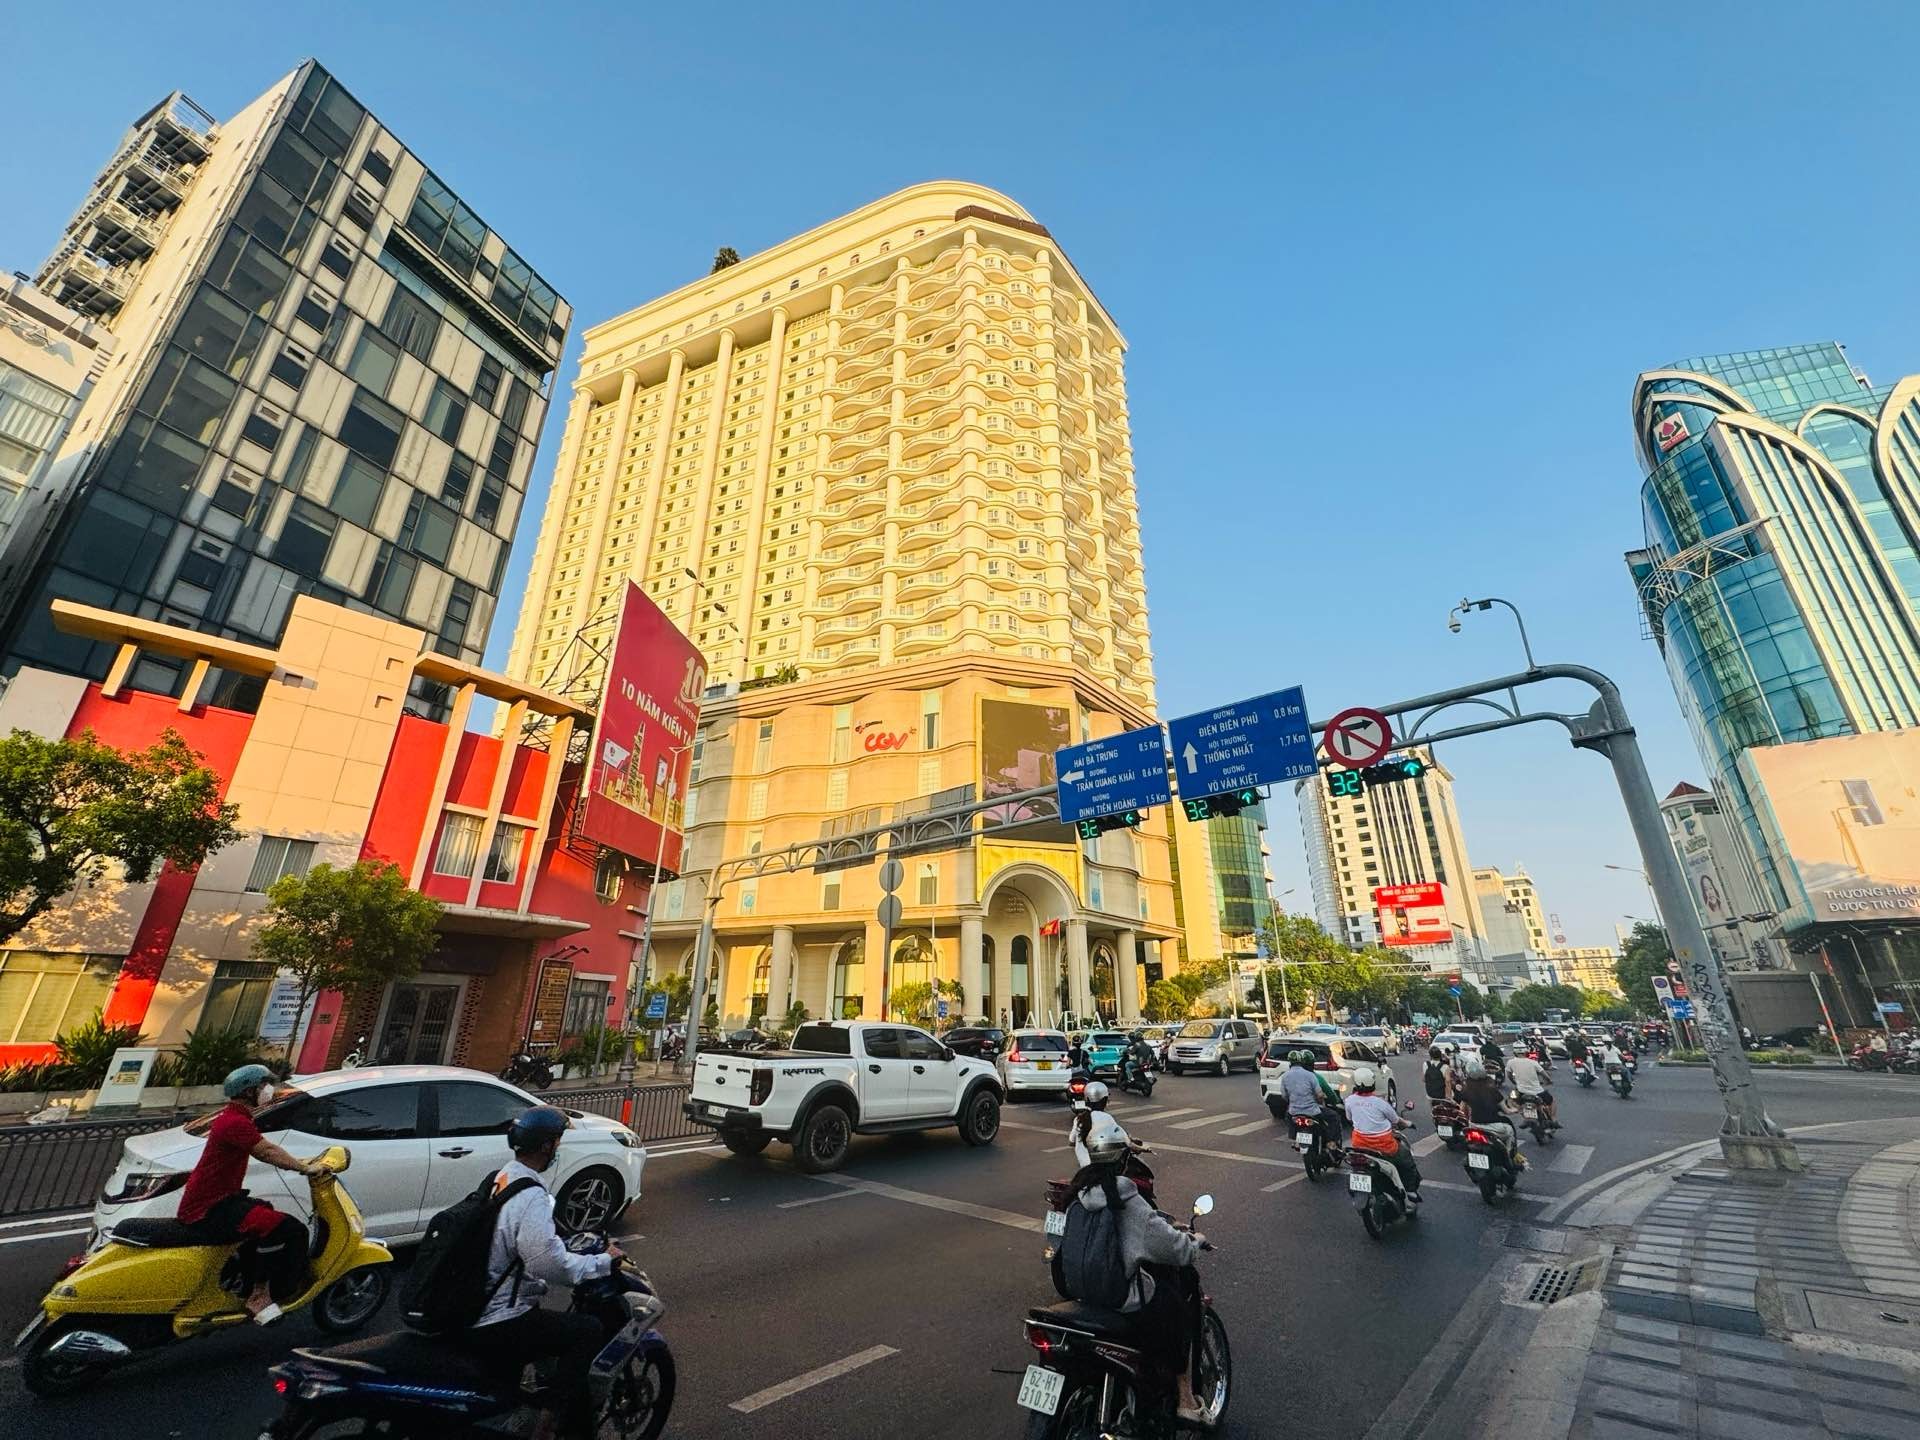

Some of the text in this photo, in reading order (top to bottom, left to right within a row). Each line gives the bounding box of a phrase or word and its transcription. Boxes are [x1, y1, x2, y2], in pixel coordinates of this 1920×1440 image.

[682, 656, 706, 700] 10
[621, 677, 635, 700] 10
[636, 691, 662, 722] NĂM
[1199, 723, 1218, 737] ĐIỆN
[1220, 718, 1239, 733] BIÊN
[1287, 704, 1300, 716] Km
[865, 732, 909, 752] CGV
[1204, 747, 1231, 764] THỐNG
[1232, 742, 1254, 757] NHẤT
[1292, 734, 1306, 745] Km
[1073, 756, 1085, 768] HAI
[1086, 752, 1095, 764] BÀ
[1095, 749, 1119, 762] TRƯNG
[1149, 740, 1160, 749] Km
[1095, 775, 1117, 789] QUANG
[1240, 772, 1259, 785] KIỆT
[1299, 764, 1312, 775] Km
[1331, 771, 1359, 795] 32
[1113, 798, 1137, 811] HOÀNG
[1156, 793, 1167, 802] Km
[1185, 800, 1208, 820] 32
[1823, 887, 1883, 900] THƯƠNG
[1830, 900, 1869, 912] ĐƯỢC
[1871, 899, 1895, 909] TIN
[782, 1067, 826, 1077] RAPTOR
